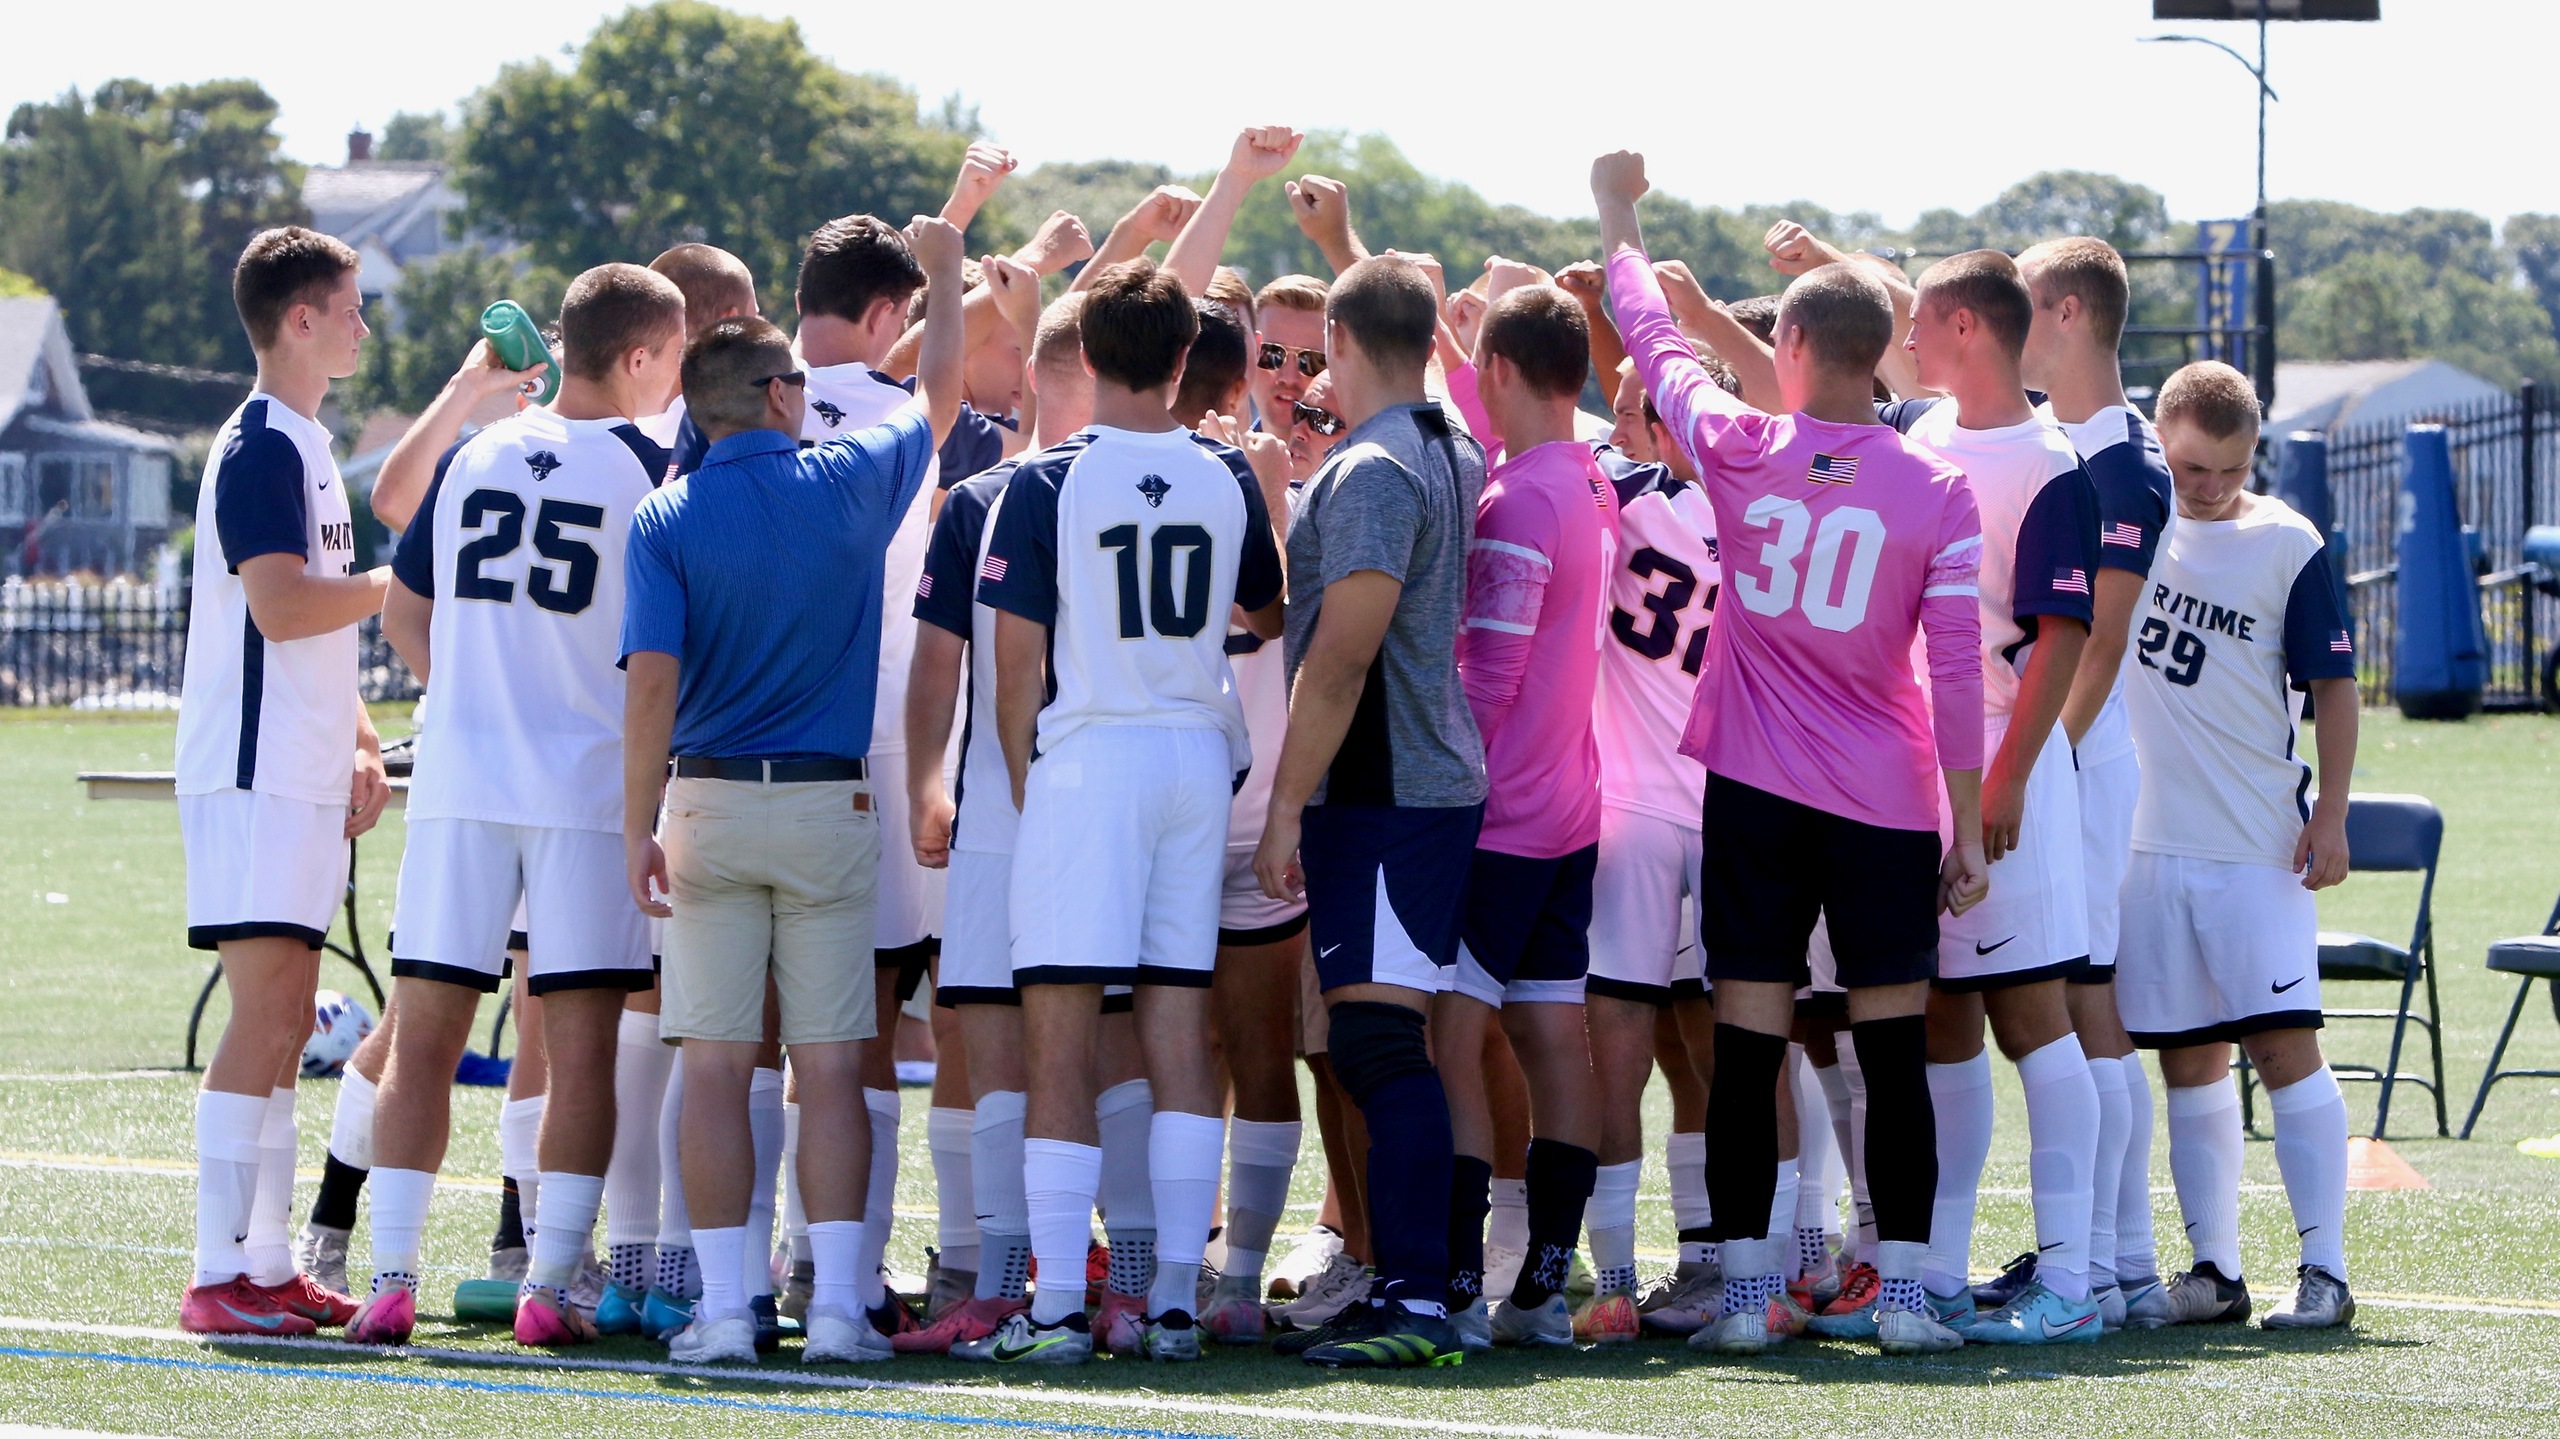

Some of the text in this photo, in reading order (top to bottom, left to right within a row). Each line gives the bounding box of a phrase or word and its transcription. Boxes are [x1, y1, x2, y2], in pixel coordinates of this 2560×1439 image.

[454, 486, 607, 616] 25
[1097, 522, 1214, 641] 10
[1734, 493, 1887, 634] 30
[2137, 615, 2207, 687] 29
